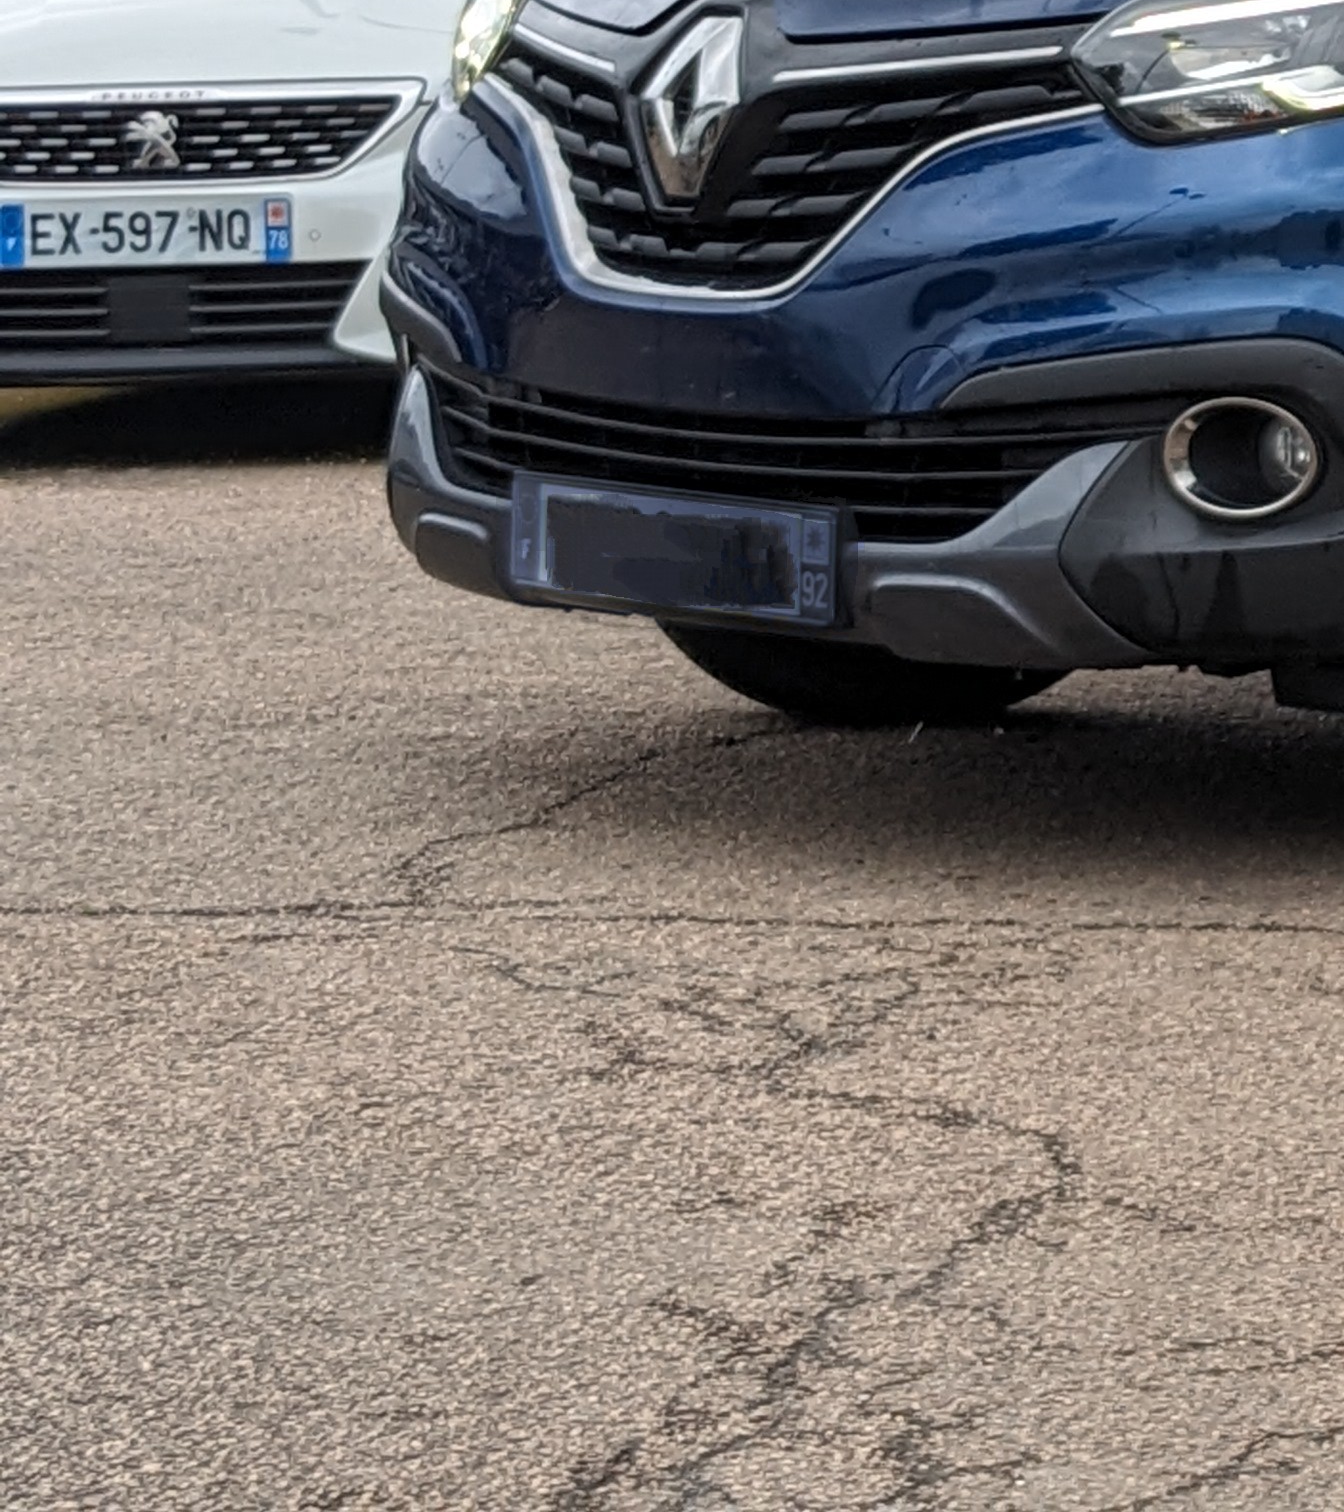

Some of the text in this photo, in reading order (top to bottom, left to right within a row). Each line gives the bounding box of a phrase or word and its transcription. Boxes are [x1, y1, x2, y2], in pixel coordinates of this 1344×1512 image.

[101, 90, 206, 101] PEUGEOT
[30, 208, 251, 256] EX-597-NQ
[268, 229, 289, 249] 78
[802, 571, 828, 609] 92
